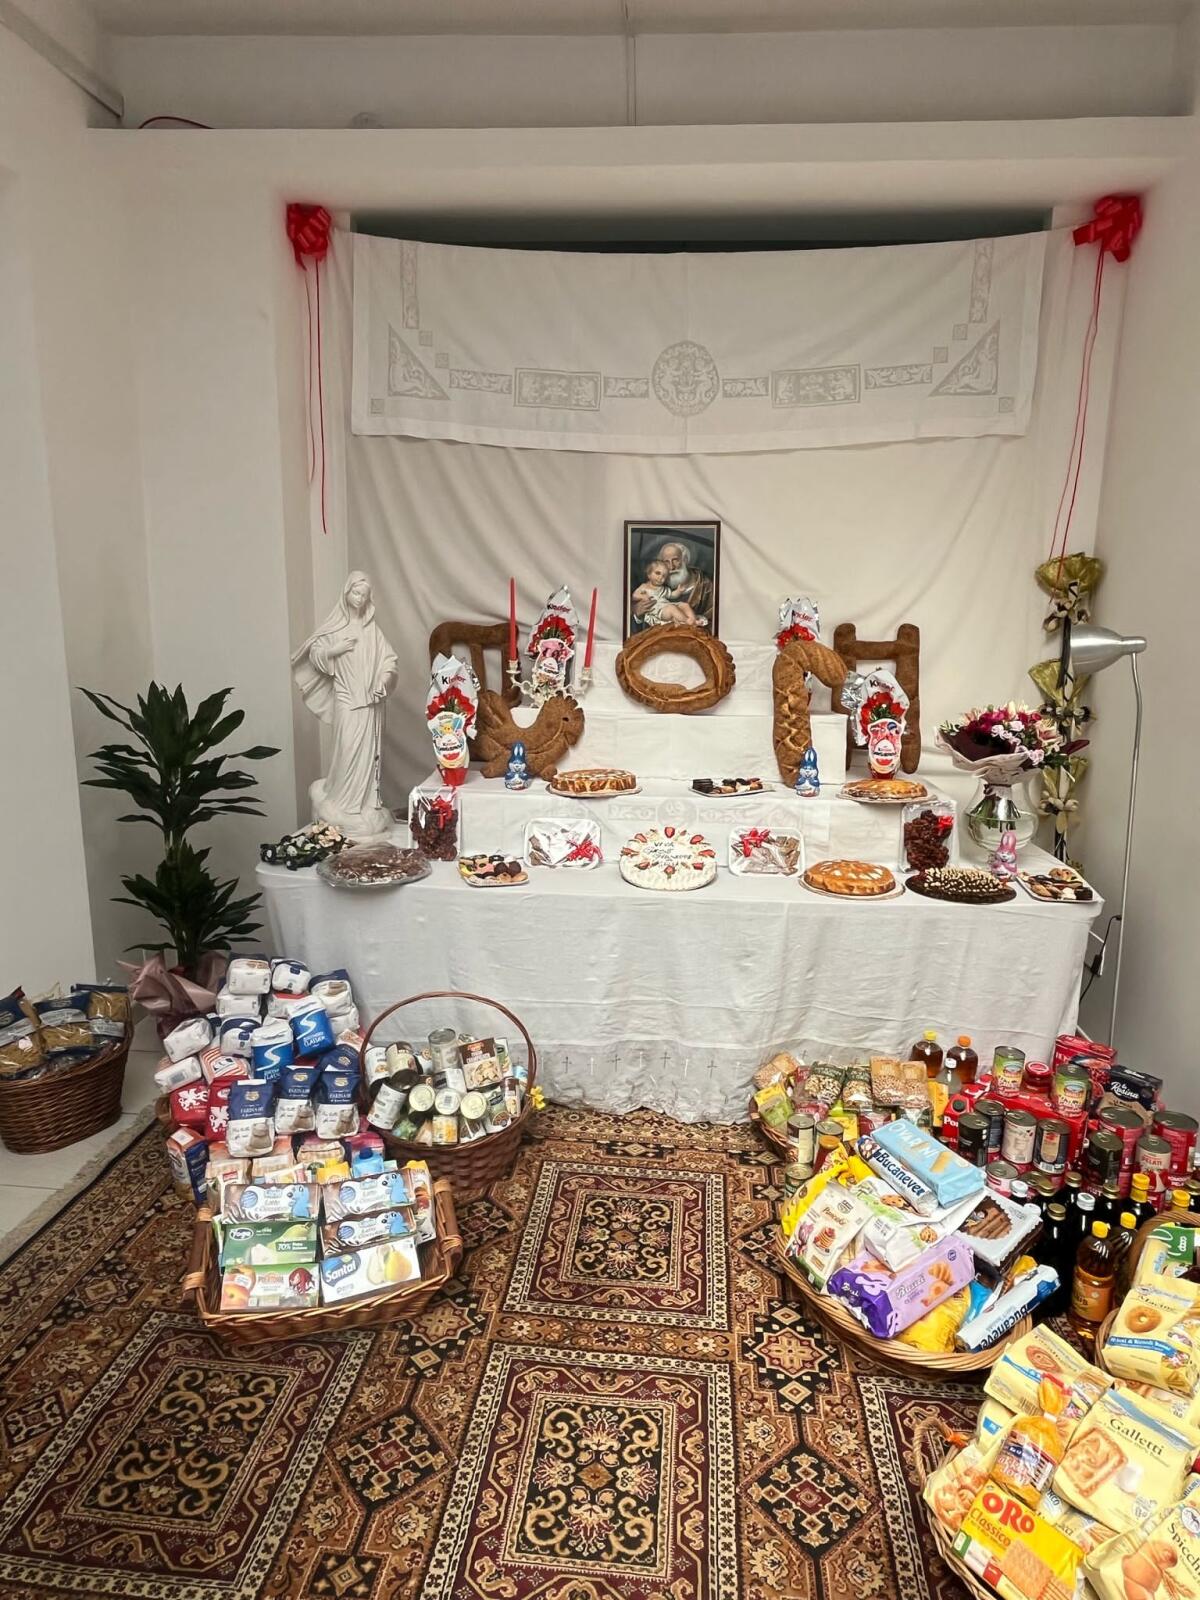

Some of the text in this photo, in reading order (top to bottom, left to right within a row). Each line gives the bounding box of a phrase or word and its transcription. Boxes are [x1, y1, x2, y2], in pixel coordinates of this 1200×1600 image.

[1110, 1081, 1140, 1099] Rosina
[876, 1152, 922, 1194] Bucaneve
[325, 1260, 357, 1282] Santal
[1109, 1418, 1165, 1456] Galletti
[970, 1507, 1012, 1547] Classico
[982, 1491, 1036, 1534] ORO
